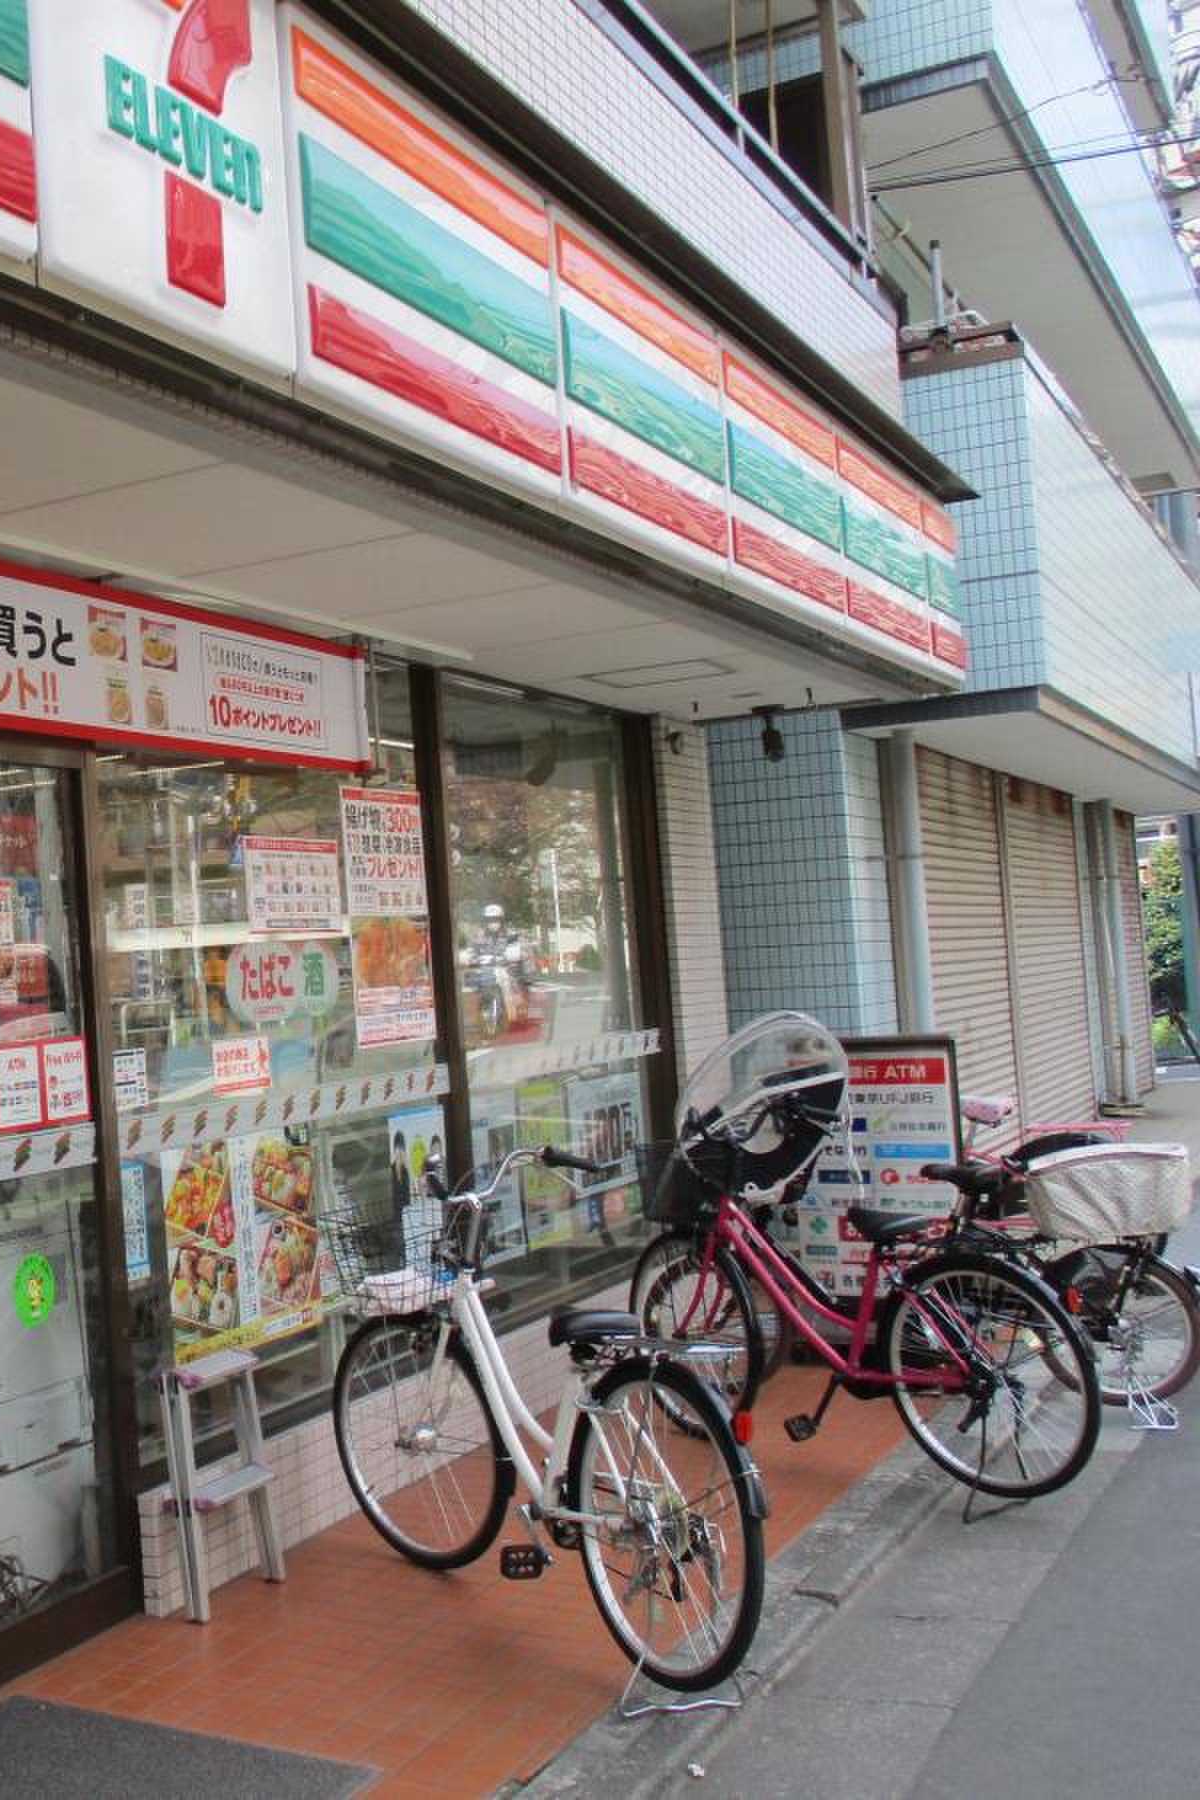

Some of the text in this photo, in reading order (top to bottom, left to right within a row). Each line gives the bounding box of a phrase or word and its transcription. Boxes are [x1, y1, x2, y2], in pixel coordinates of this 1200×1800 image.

[240, 954, 295, 1001] たばこ
[883, 1064, 927, 1080] ATM
